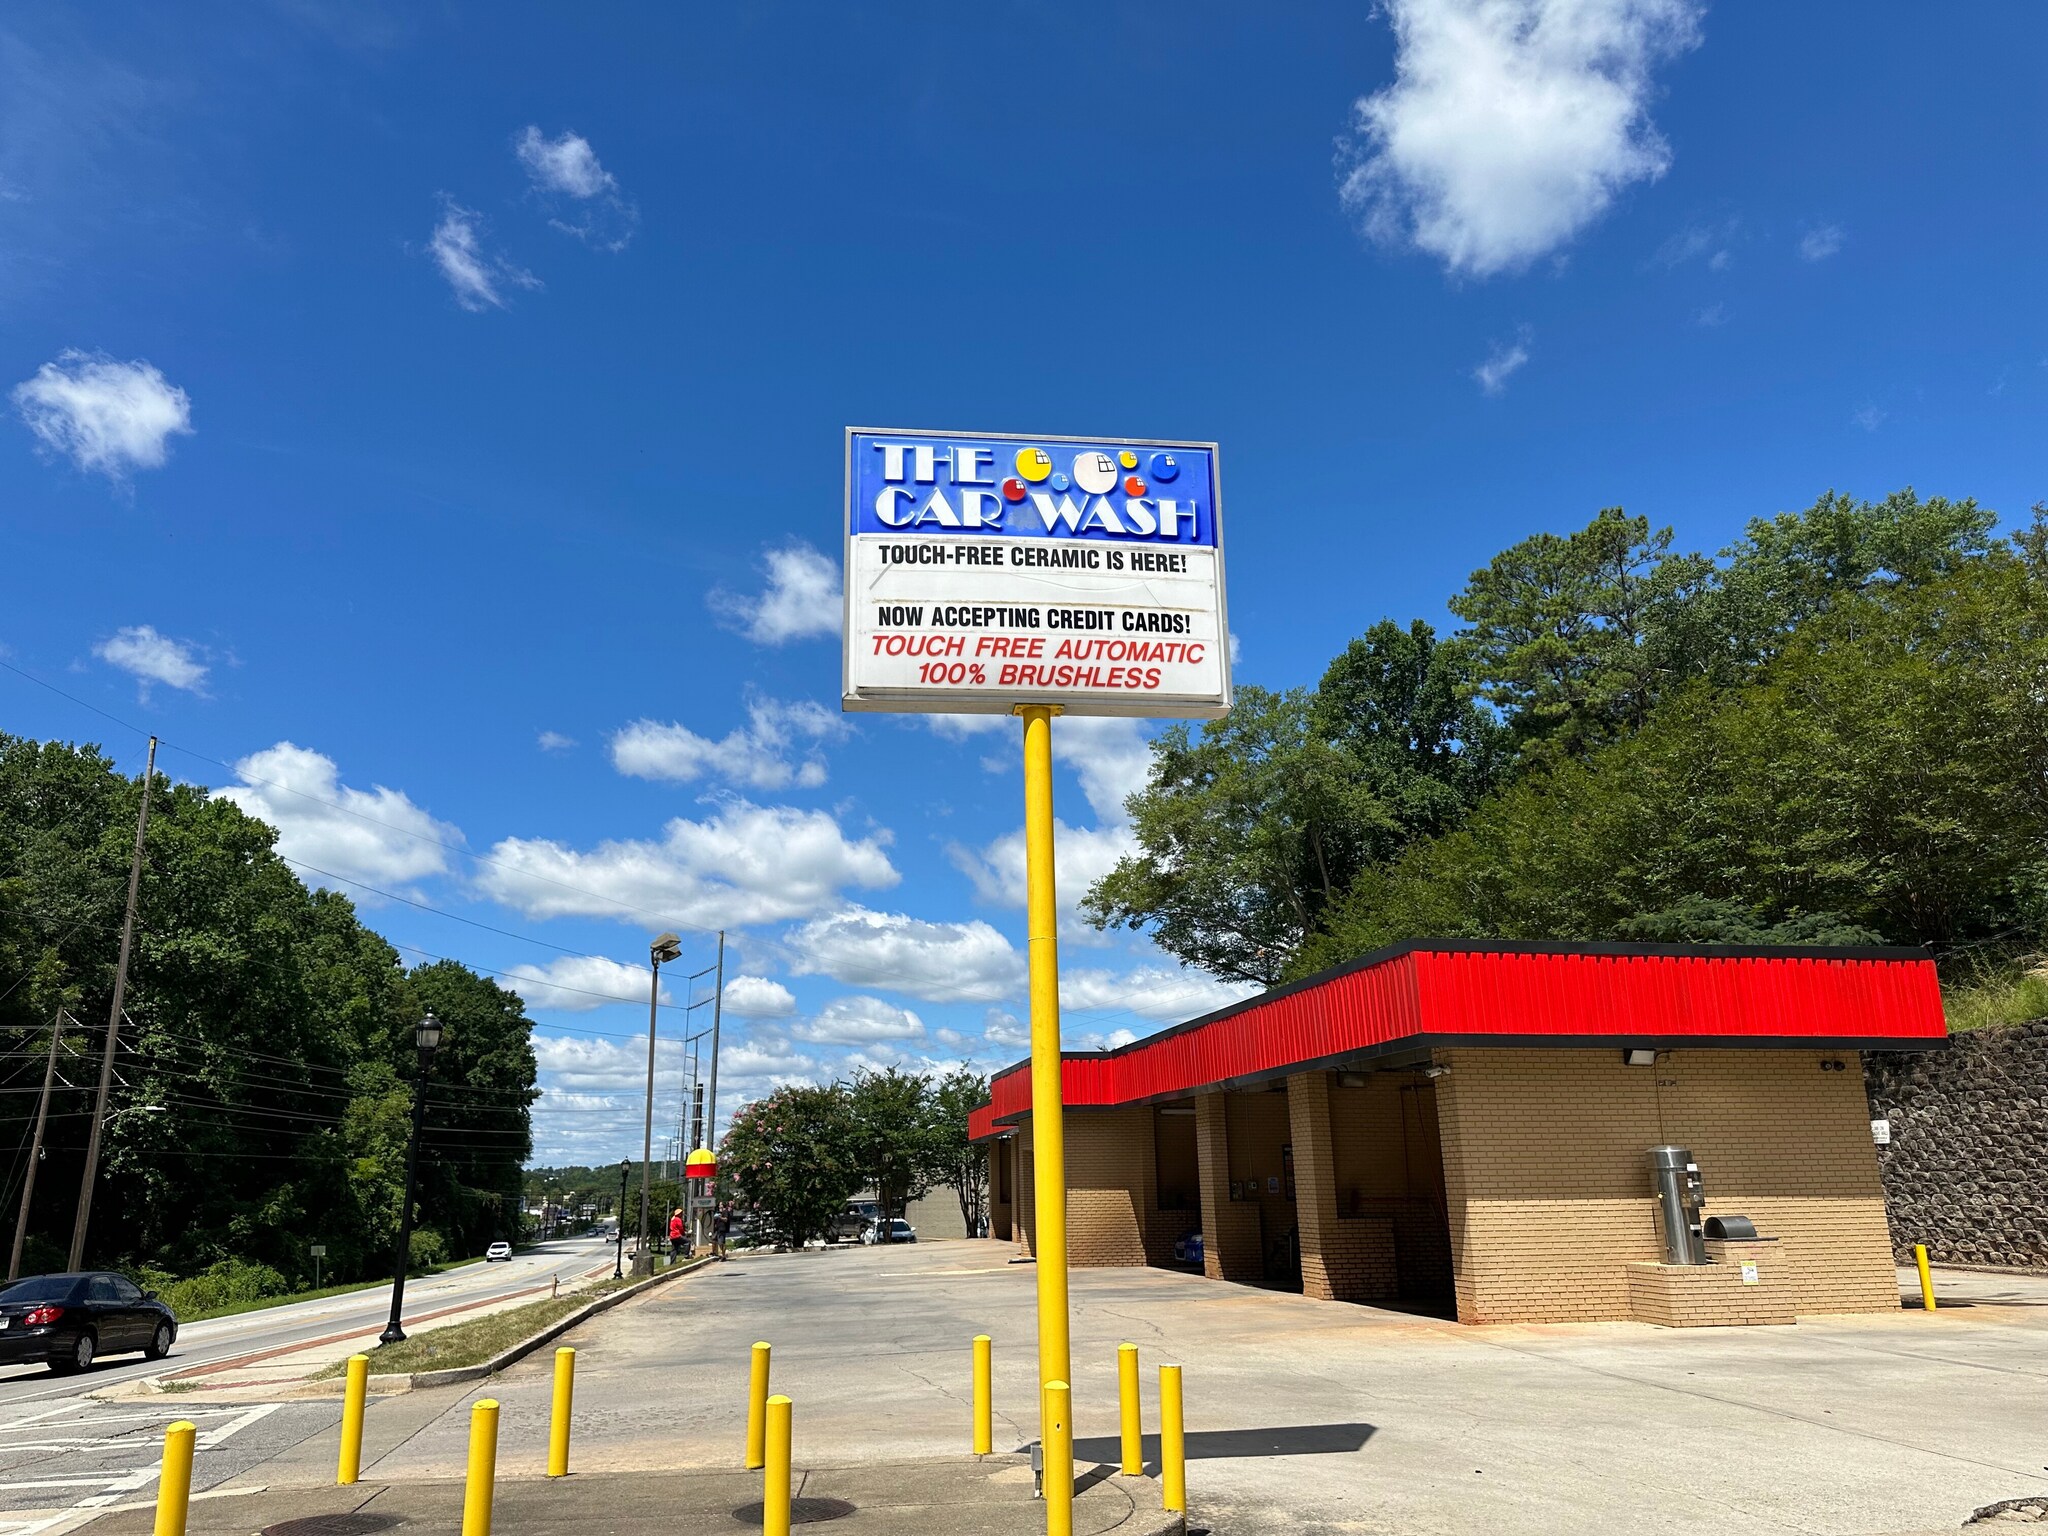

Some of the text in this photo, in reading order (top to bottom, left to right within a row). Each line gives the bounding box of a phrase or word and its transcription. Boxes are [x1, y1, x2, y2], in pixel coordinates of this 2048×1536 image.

[873, 441, 994, 483] THE
[875, 486, 1197, 538] CAR WASH
[879, 545, 1187, 573] TOUCH-FREE CERAMIC IS HERE!
[878, 606, 1191, 634] NOW ACCEPTING CREDIT CARDS!
[872, 635, 1205, 664] TOUCH FREE AUTOMATIC
[919, 662, 1162, 690] 100% BRUSHLESS
